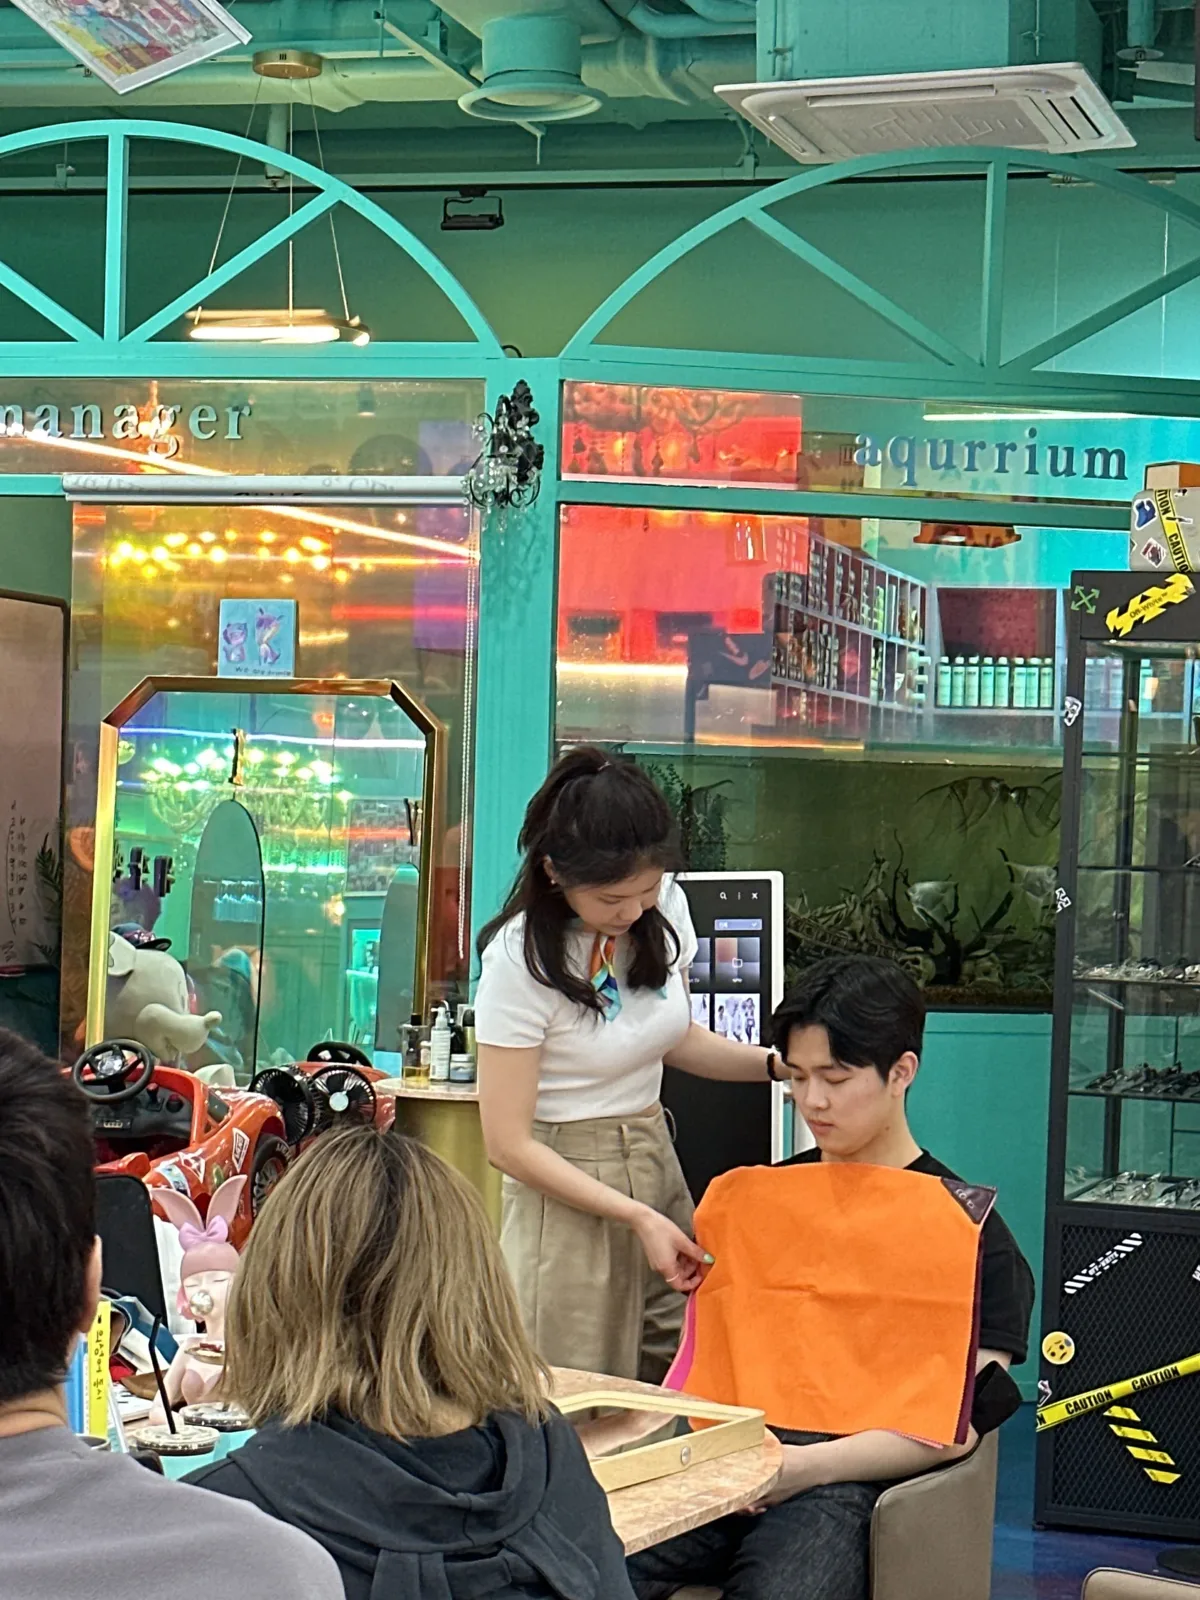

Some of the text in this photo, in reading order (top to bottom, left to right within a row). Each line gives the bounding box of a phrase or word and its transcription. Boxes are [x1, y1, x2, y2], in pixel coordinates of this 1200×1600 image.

[853, 426, 1129, 487] aqurrium
[1064, 1366, 1181, 1415] CAUTION CAUTION
